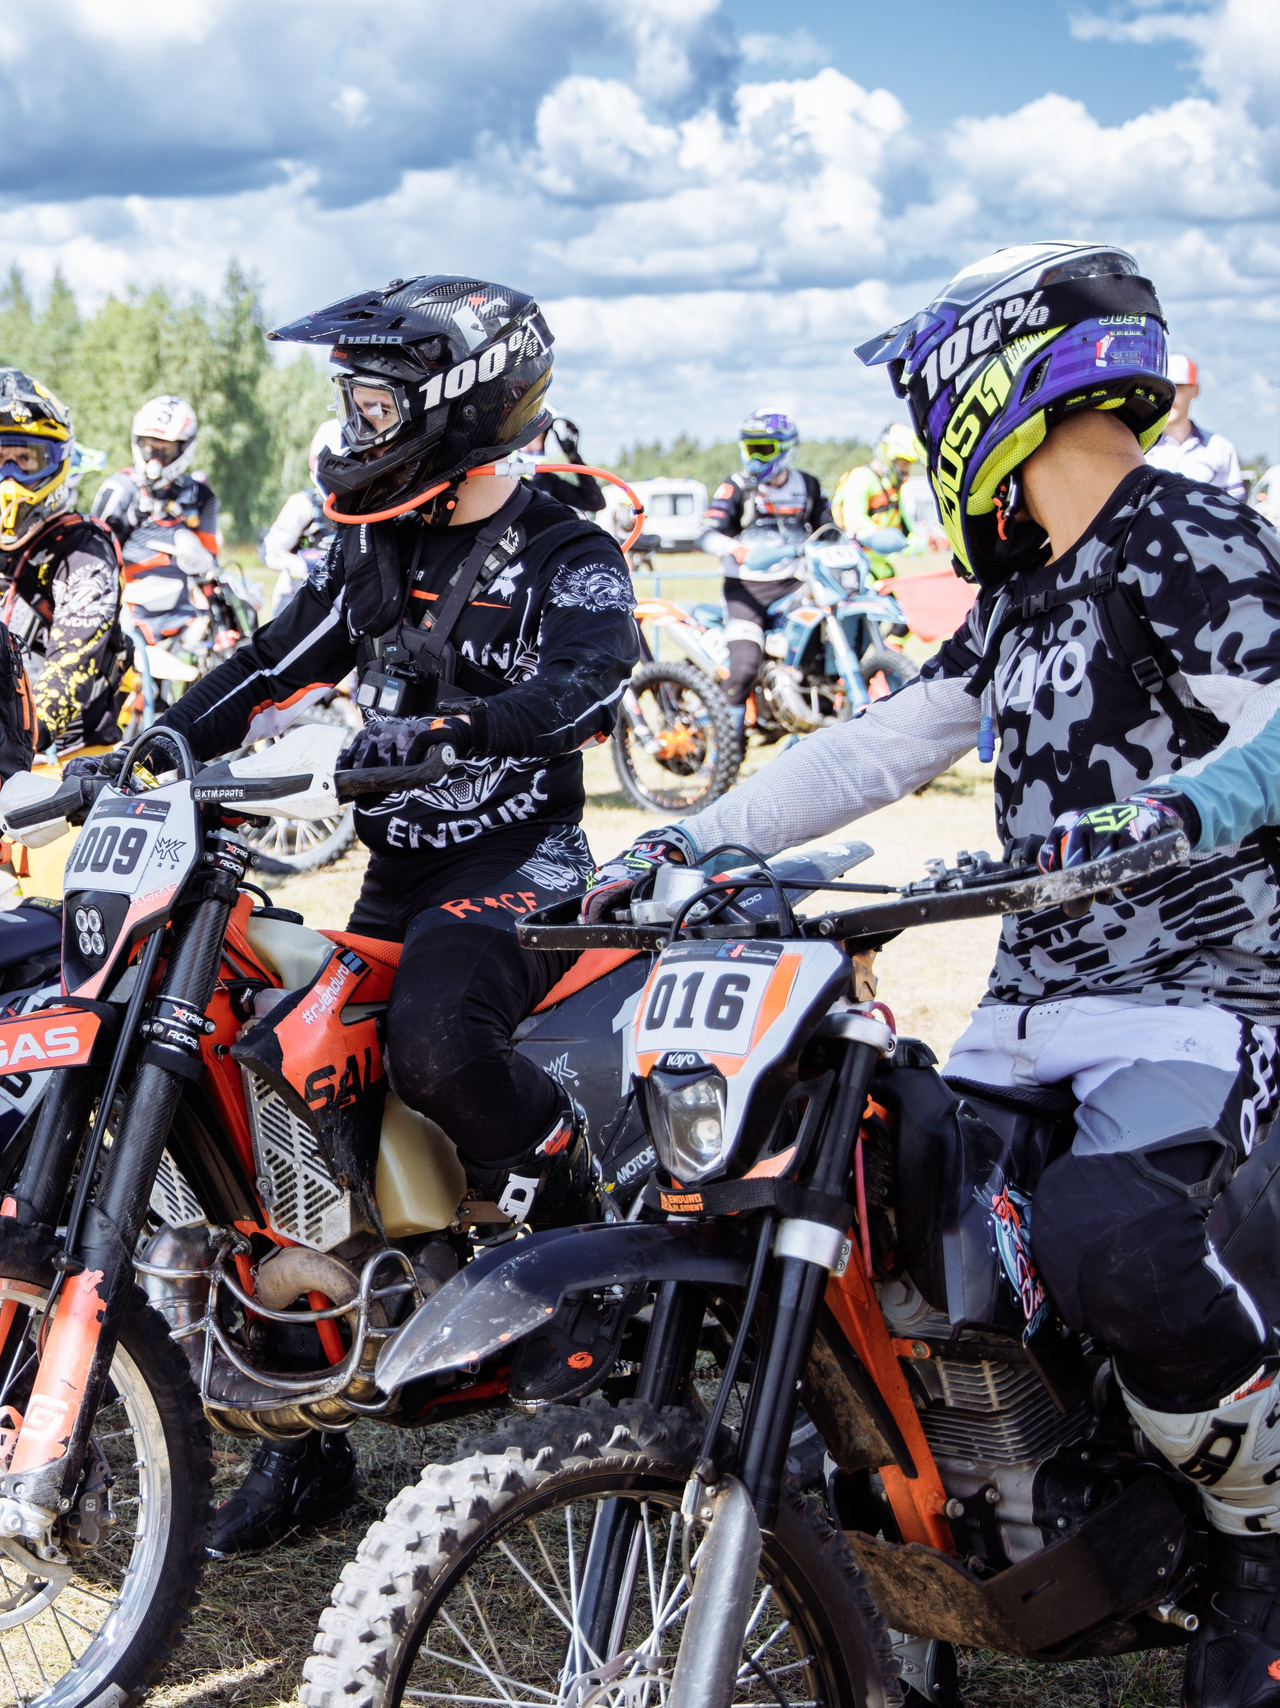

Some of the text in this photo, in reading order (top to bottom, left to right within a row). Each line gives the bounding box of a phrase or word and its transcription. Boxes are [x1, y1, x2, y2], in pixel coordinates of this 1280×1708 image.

[338, 334, 403, 344] hebo
[920, 290, 1049, 401] 100%
[419, 331, 538, 411] 100%
[932, 357, 1012, 525] JUST1
[73, 825, 148, 875] 009
[172, 1004, 203, 1026] XTRIG
[645, 972, 751, 1031] 016
[666, 1054, 696, 1068] KAYO
